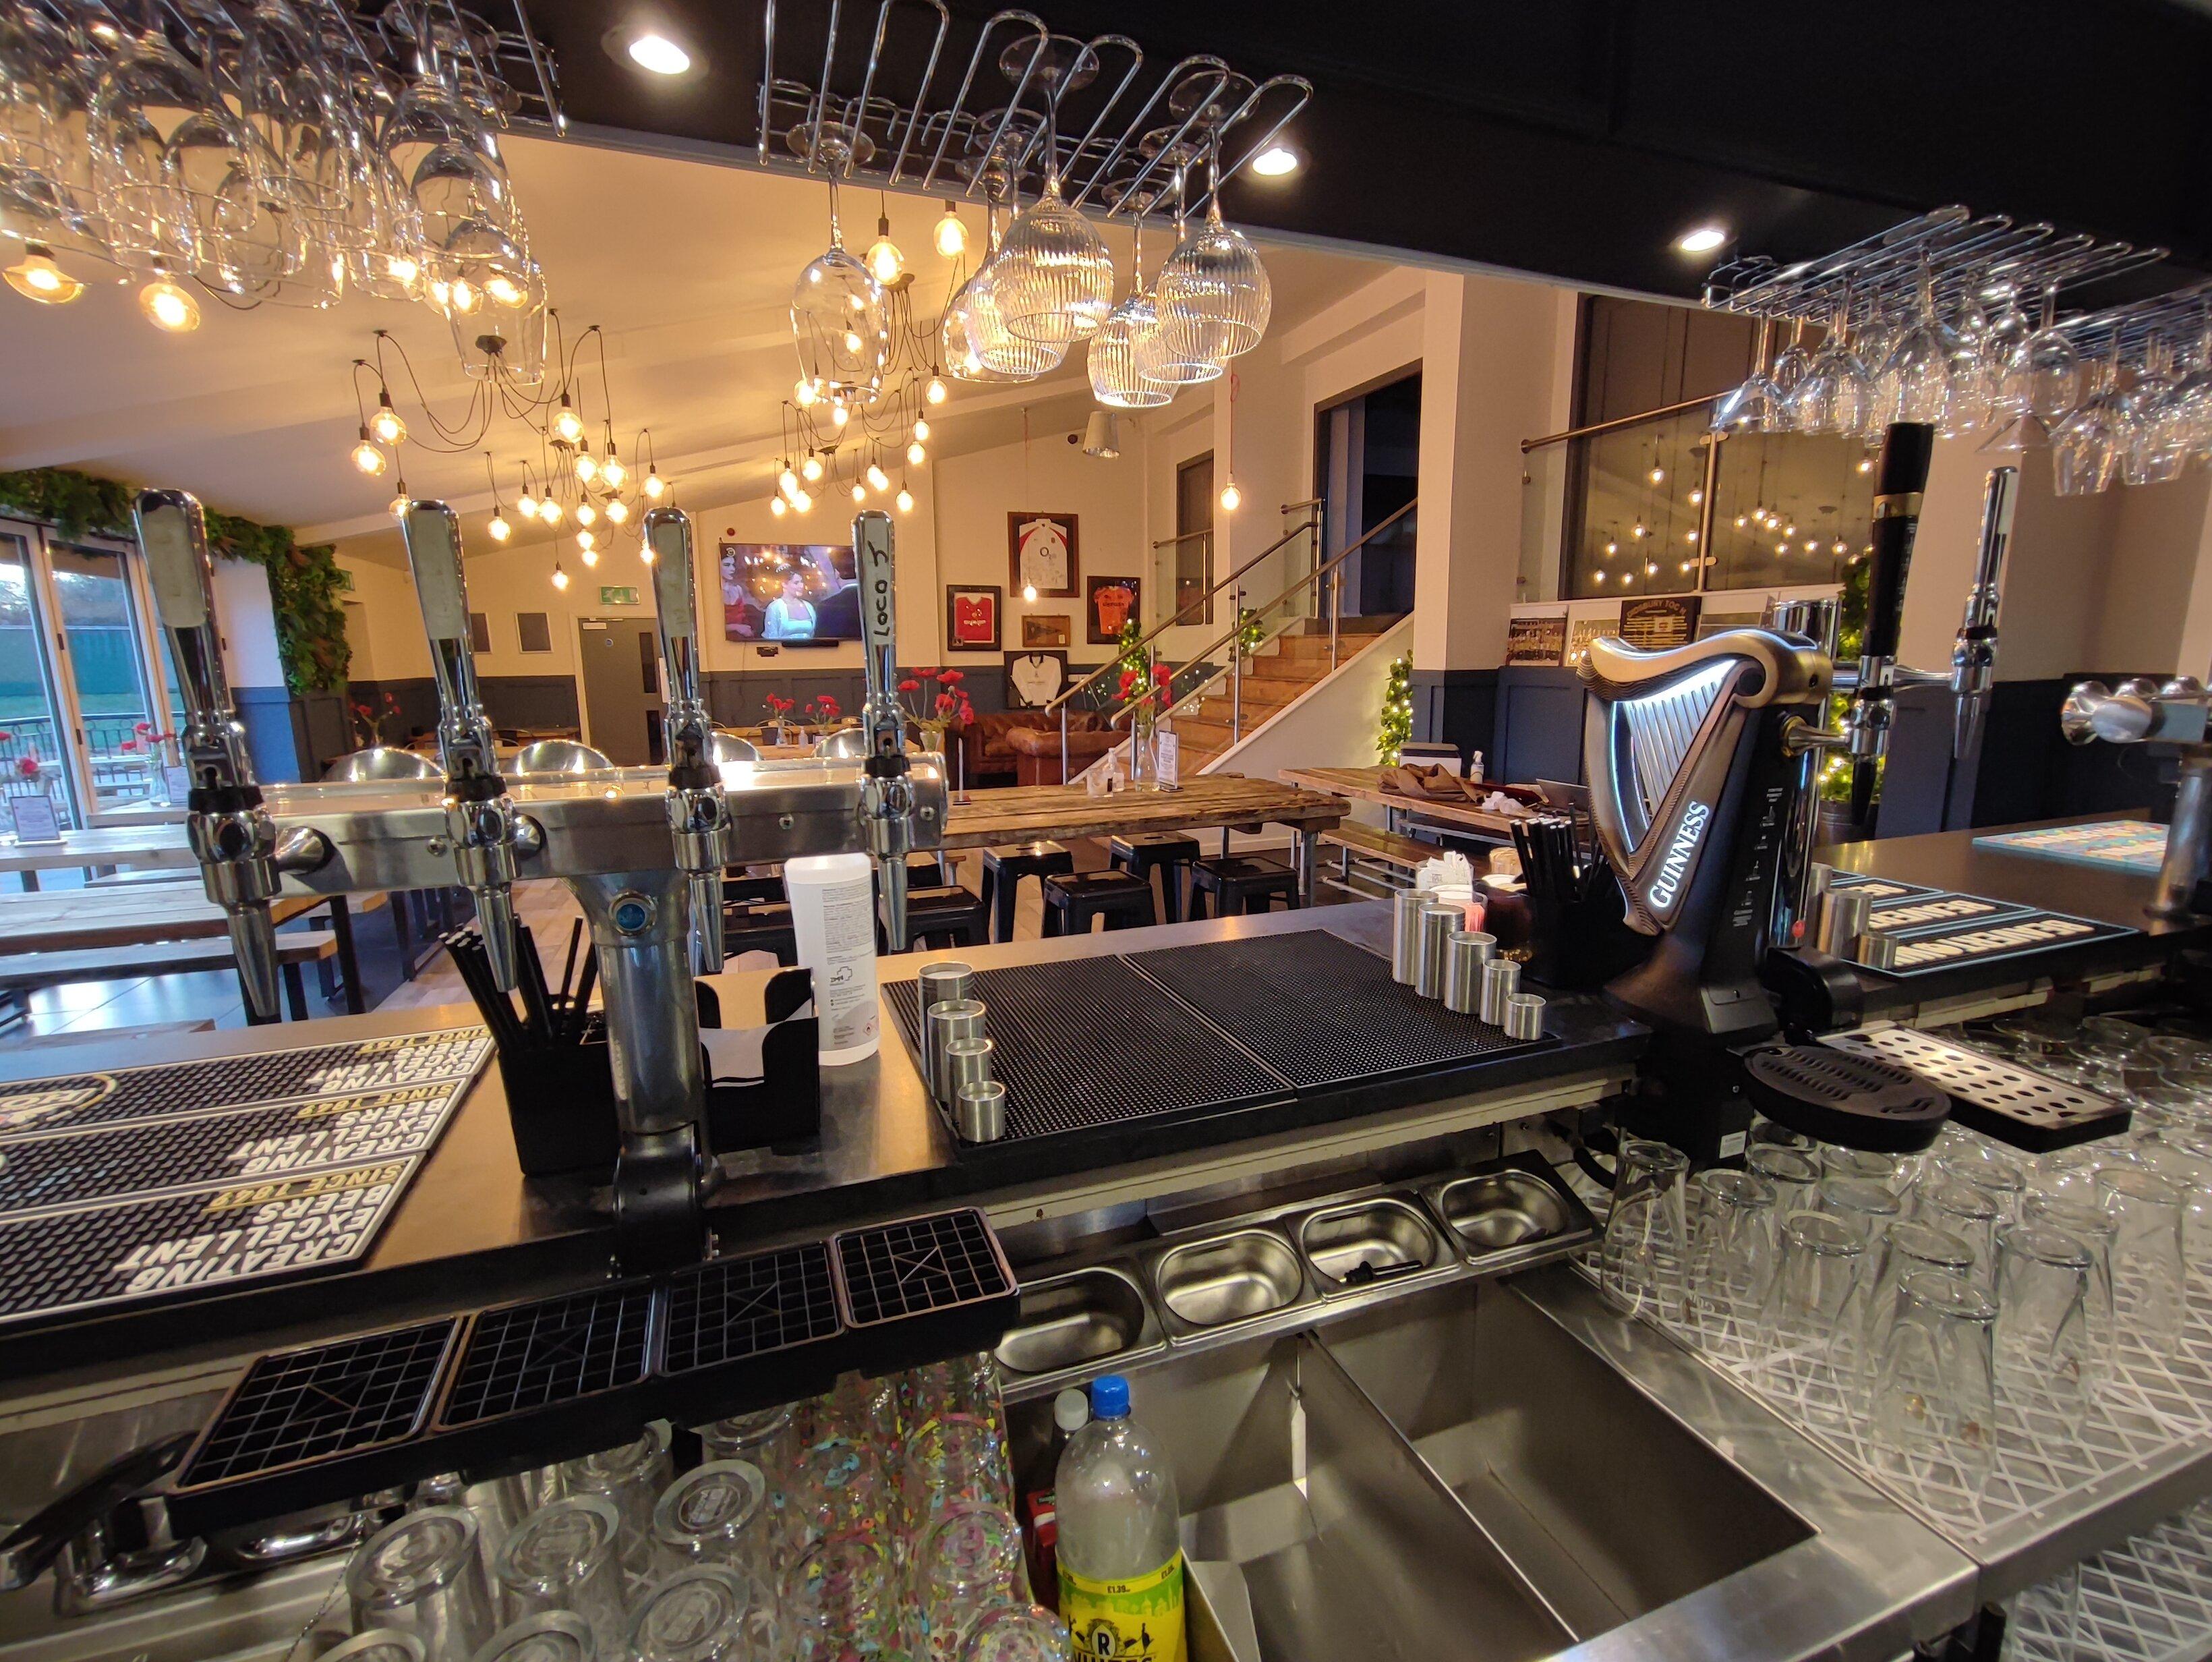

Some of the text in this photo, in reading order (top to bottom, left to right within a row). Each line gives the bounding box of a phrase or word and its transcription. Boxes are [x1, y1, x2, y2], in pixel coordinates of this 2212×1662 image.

[873, 579, 890, 637] LOCO
[1649, 801, 1710, 909] GUINNESS
[395, 1037, 488, 1060] BEERS
[427, 1027, 491, 1043] SINCE
[305, 1049, 482, 1085] EXCELLENT
[318, 1062, 472, 1093] CREATING
[299, 1083, 456, 1116] SINCE 1849
[335, 1097, 448, 1128] BEERS
[226, 1114, 439, 1161] EXCELLENT
[240, 1132, 426, 1175] CREATING
[209, 1164, 403, 1207] SINCE 1849
[252, 1183, 392, 1225] BEERS
[112, 1206, 376, 1273] EXCELLENT
[125, 1233, 358, 1294] CREATING
[1097, 1632, 1110, 1656] R
